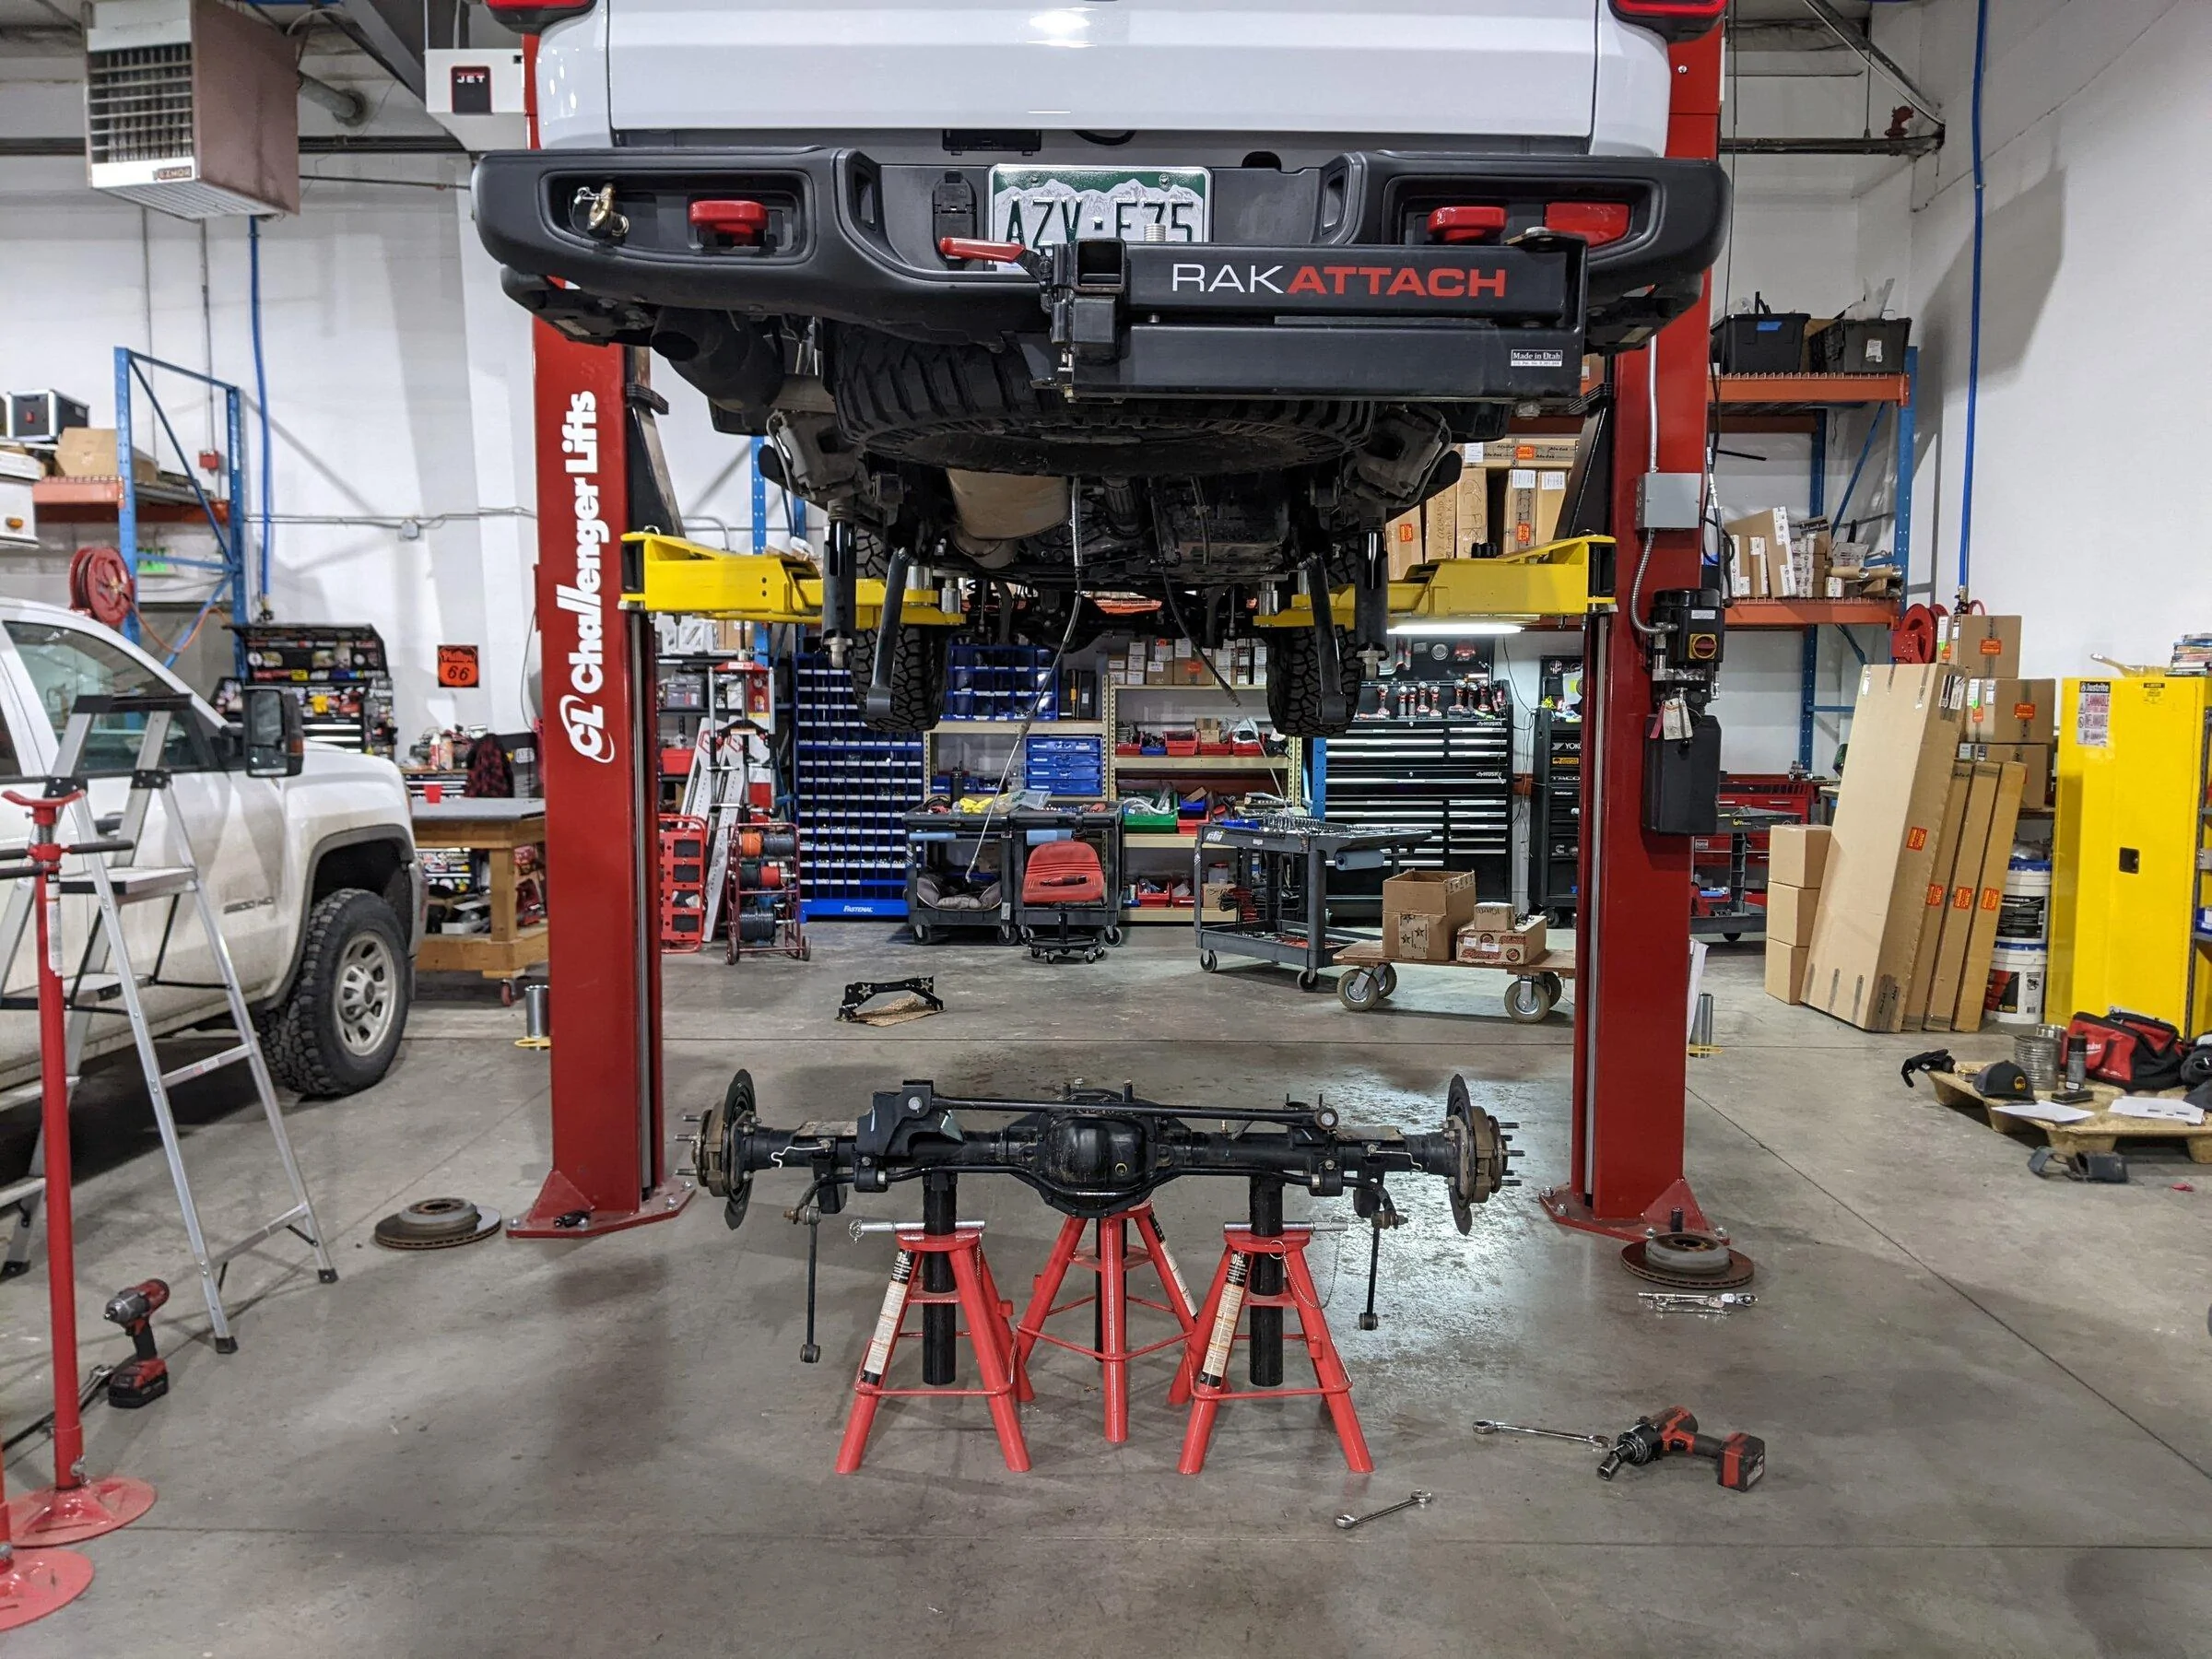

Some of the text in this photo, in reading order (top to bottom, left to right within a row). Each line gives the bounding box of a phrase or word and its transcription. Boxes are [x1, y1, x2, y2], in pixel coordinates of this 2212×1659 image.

[456, 74, 486, 84] JET
[1512, 351, 1560, 360] Made in Utah
[561, 390, 598, 474] Lifts
[556, 477, 611, 695] Challenger
[447, 665, 470, 681] 66
